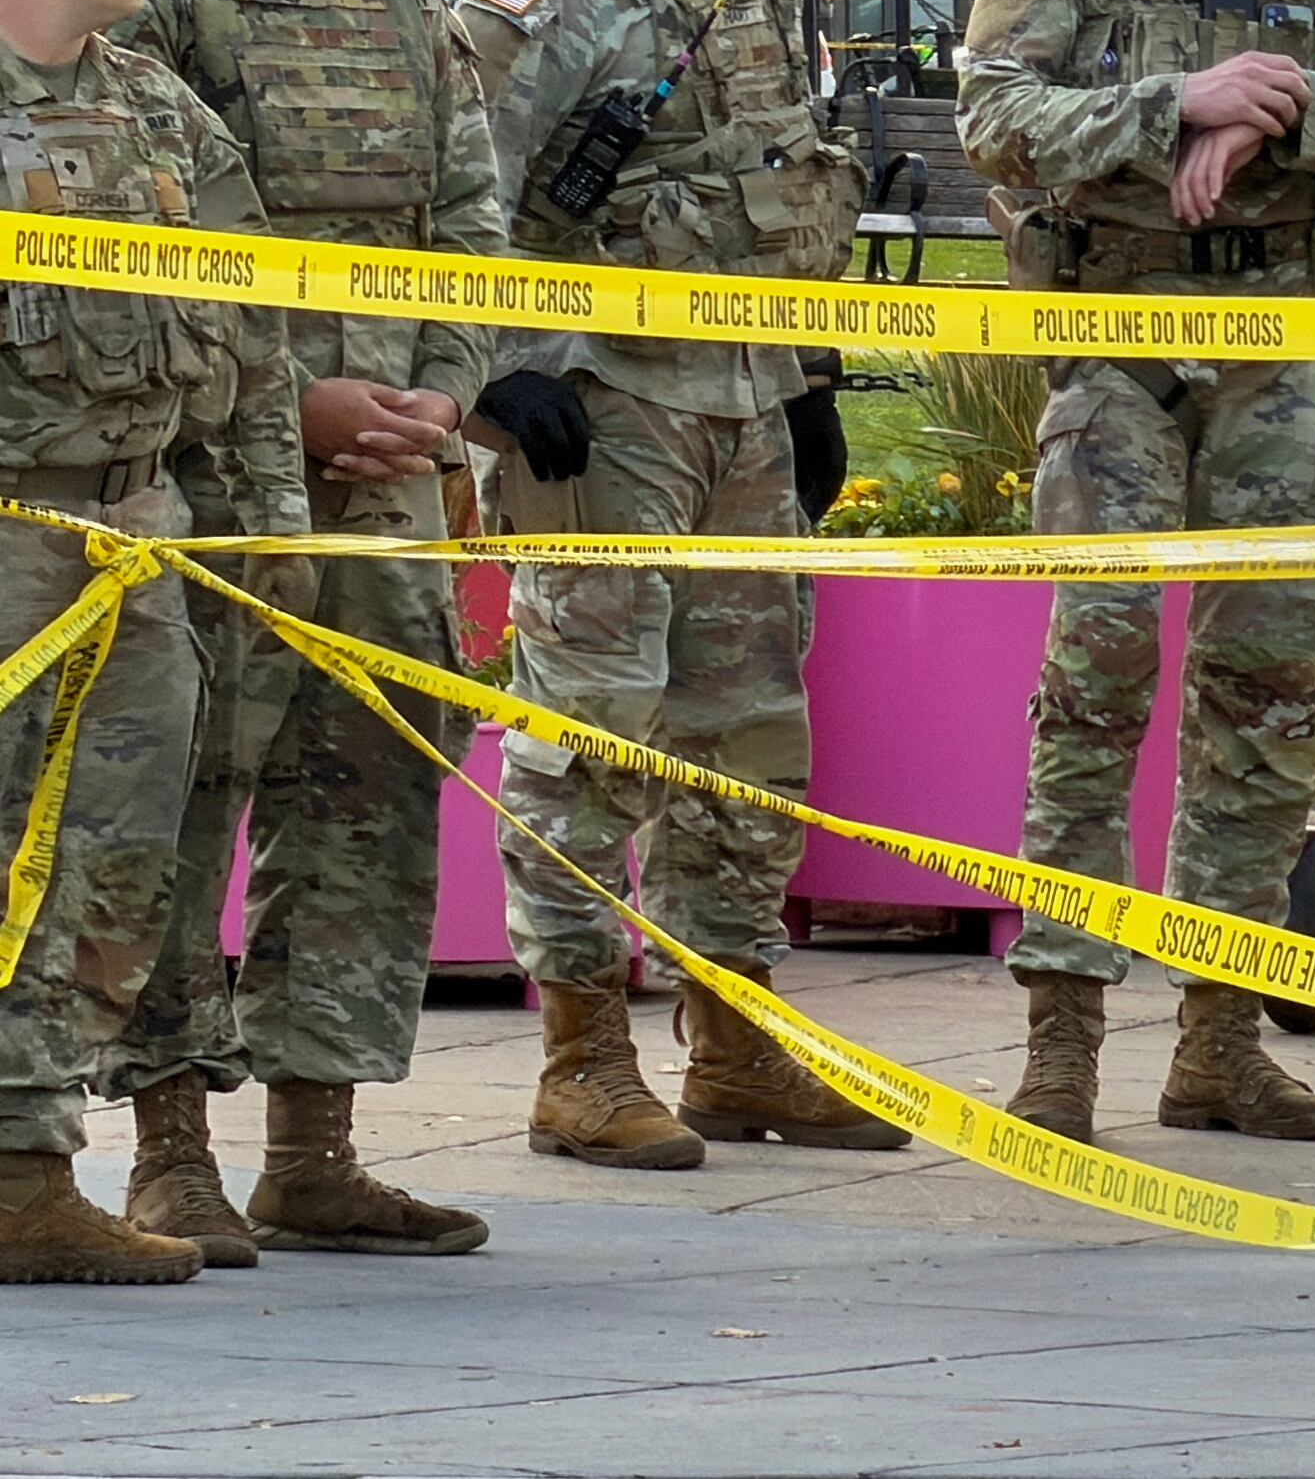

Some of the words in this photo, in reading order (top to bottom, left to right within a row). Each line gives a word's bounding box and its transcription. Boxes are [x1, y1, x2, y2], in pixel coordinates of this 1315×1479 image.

[15, 230, 77, 269] POLICE
[83, 236, 121, 273] LINE
[127, 241, 150, 277] DO
[156, 243, 192, 280] NOT
[197, 246, 255, 287] CROSS
[350, 262, 412, 301] POLICE
[419, 268, 457, 305] LINE
[463, 272, 486, 308] DO
[493, 274, 529, 311] NOT
[535, 277, 592, 317] CROSS
[690, 290, 753, 327] POLICE
[759, 295, 798, 330] LINE
[805, 297, 828, 332] DO
[835, 299, 870, 333] NOT
[877, 301, 935, 338] CROSS
[1034, 308, 1099, 343] POLICE
[1105, 310, 1144, 344] LINE
[1151, 311, 1175, 345] DO
[1181, 311, 1217, 346] NOT
[1224, 311, 1283, 347] CROSS
[1152, 911, 1228, 972] CROSS
[1220, 930, 1266, 978] NOT
[1266, 941, 1298, 986] DO
